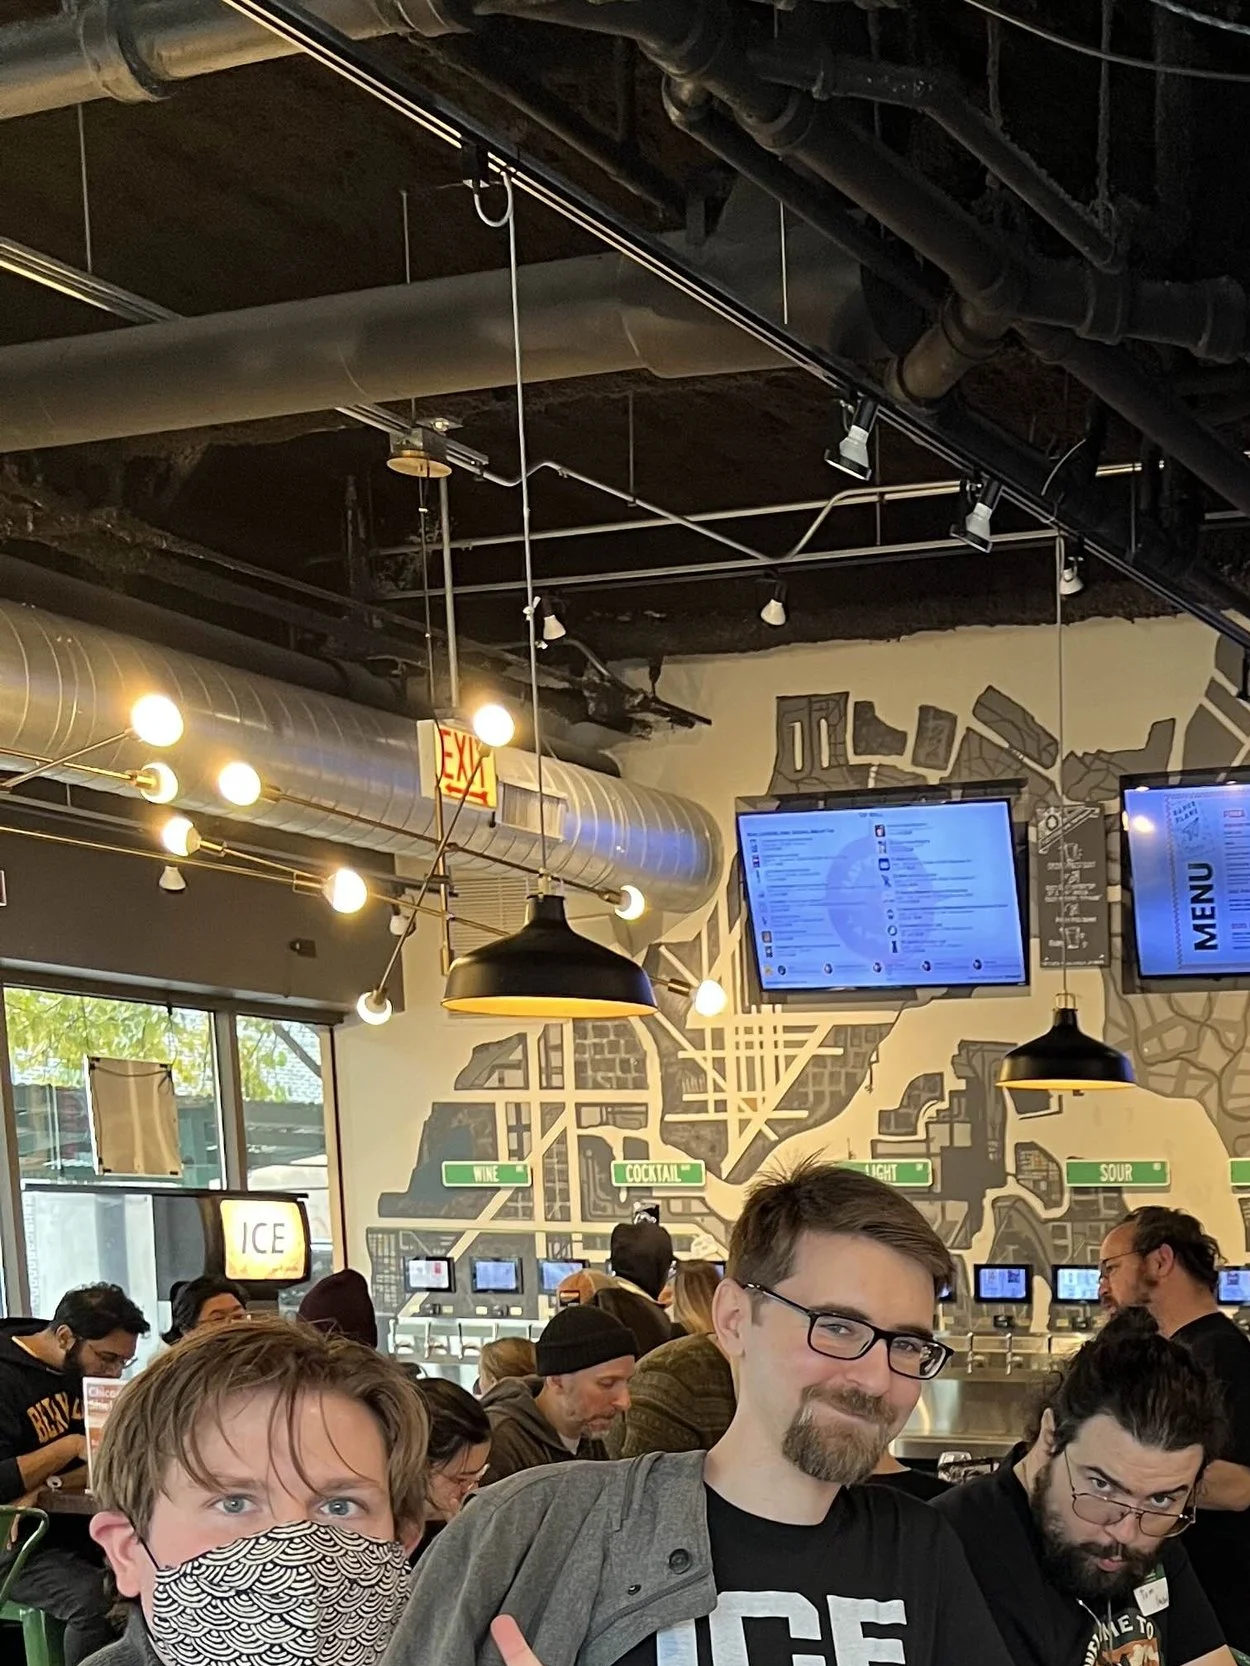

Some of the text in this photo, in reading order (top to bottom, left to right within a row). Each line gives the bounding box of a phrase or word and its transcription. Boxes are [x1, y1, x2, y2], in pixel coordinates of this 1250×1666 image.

[440, 729, 485, 788] EXIT
[1188, 863, 1218, 951] MENU
[472, 1165, 499, 1183] WINE
[625, 1164, 682, 1183] COCKTAIL
[1099, 1163, 1133, 1182] SOUR
[240, 1220, 286, 1255] ICE
[1136, 1615, 1154, 1640] TO
